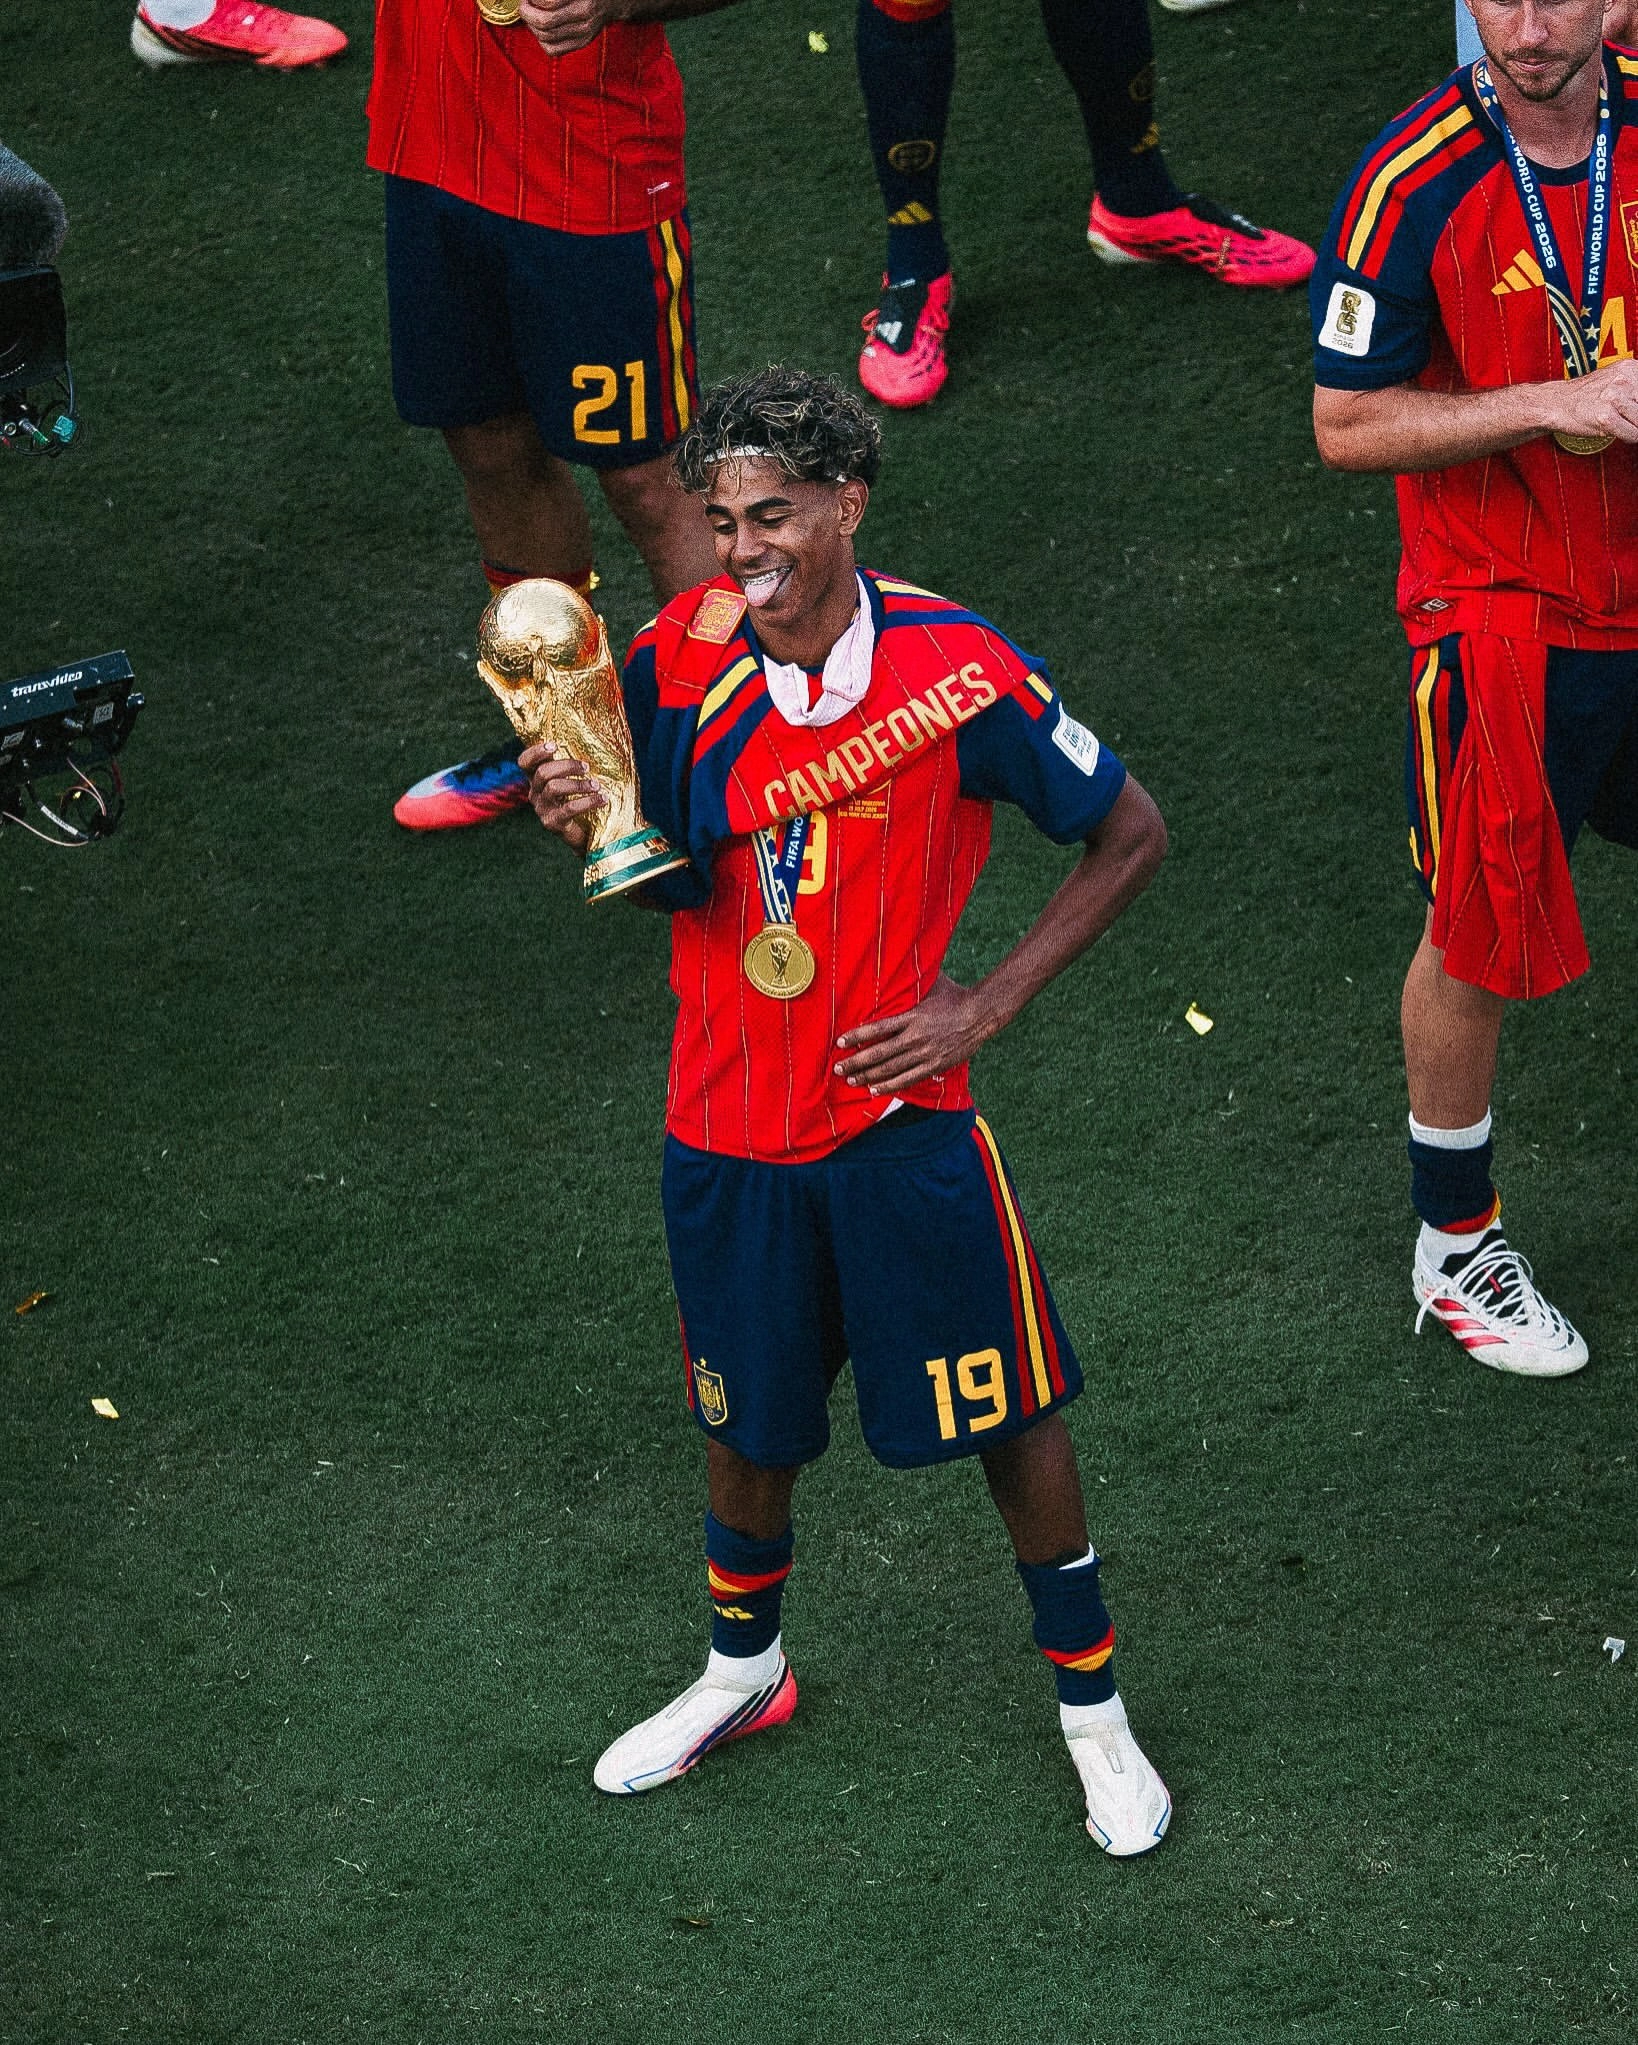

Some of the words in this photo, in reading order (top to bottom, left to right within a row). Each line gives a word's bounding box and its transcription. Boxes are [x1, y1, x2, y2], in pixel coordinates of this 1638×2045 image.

[1595, 133, 1607, 182] 2026
[1513, 146, 1534, 193] WORLD
[1527, 194, 1543, 221] CUP
[1535, 222, 1557, 269] 2026
[1593, 184, 1605, 212] CUP
[1590, 213, 1604, 265] WORLD
[1587, 265, 1599, 294] FIFA
[571, 360, 648, 444] 21
[763, 661, 997, 821] CAMPEONES
[785, 841, 800, 869] FIFA
[925, 1347, 1007, 1441] 19
